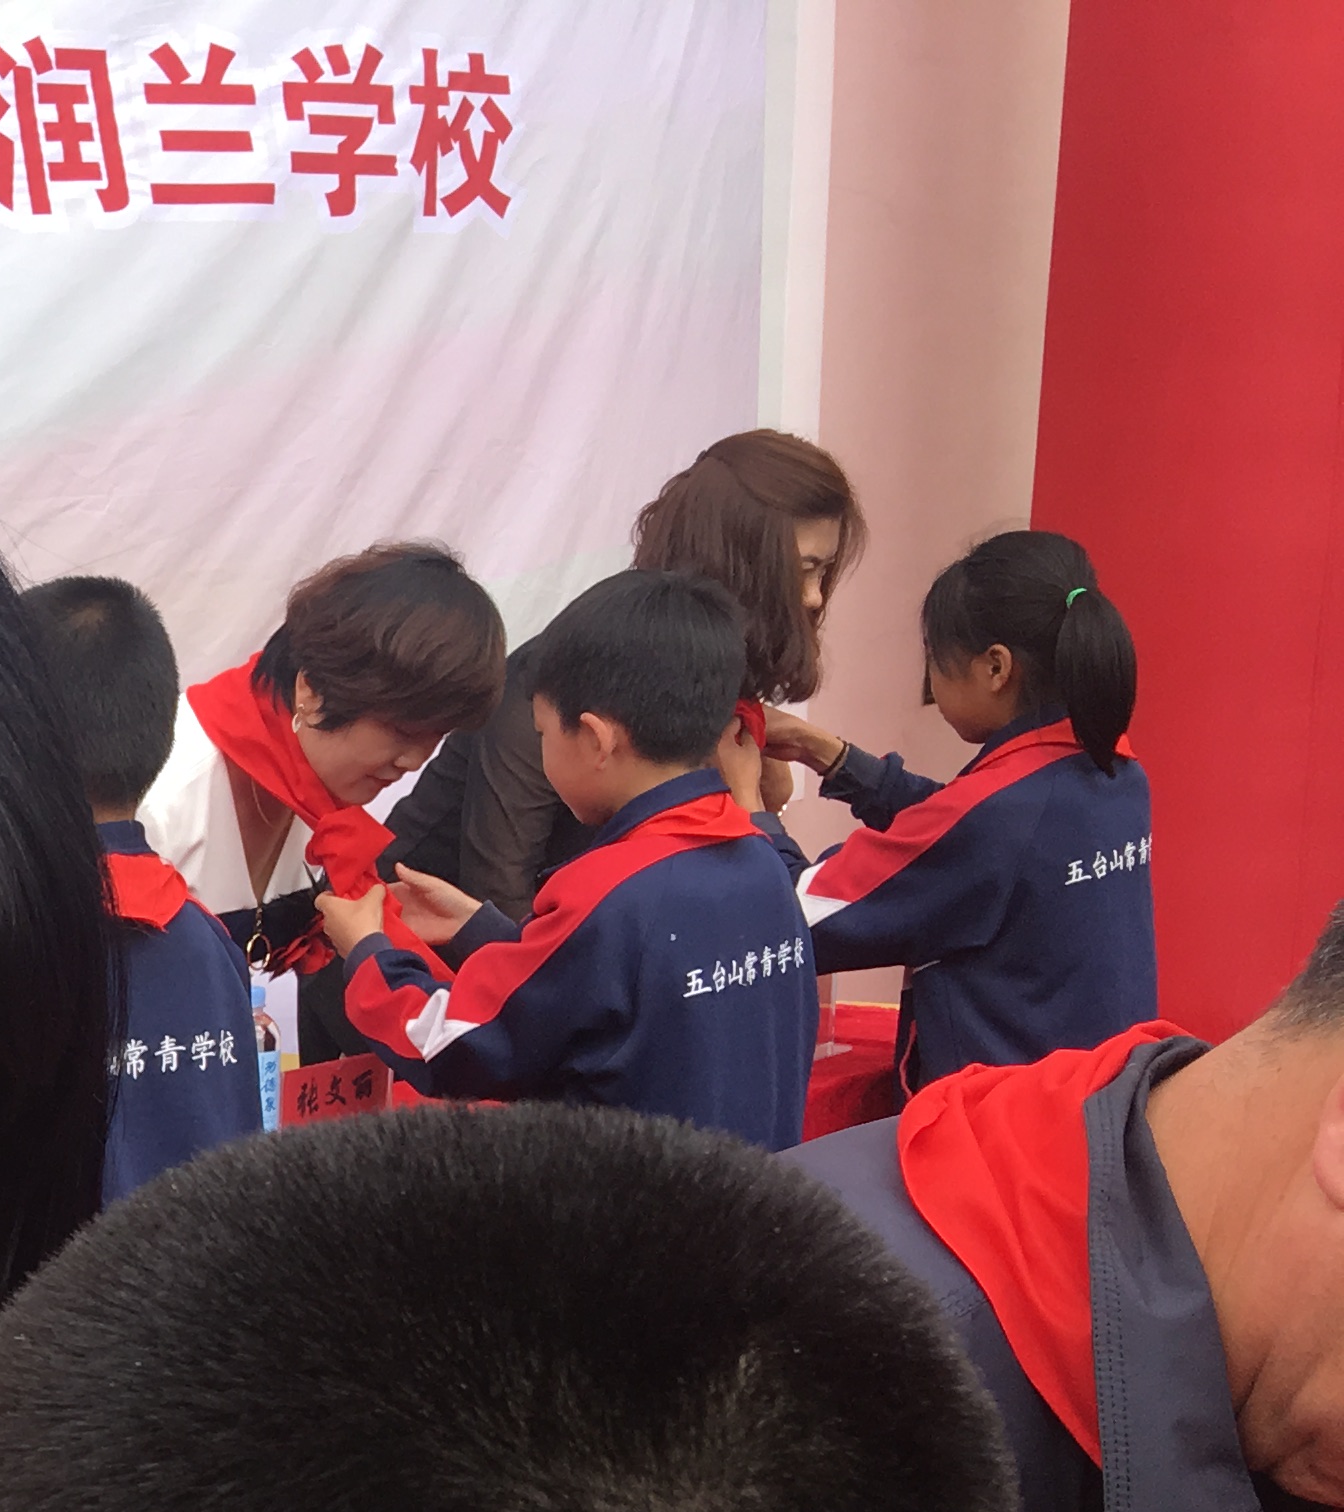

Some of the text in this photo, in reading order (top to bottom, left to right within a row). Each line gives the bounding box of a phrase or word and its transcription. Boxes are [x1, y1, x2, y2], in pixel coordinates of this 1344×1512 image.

[1064, 832, 1152, 886] 五台山常青
[682, 937, 805, 998] 五台山常青学校
